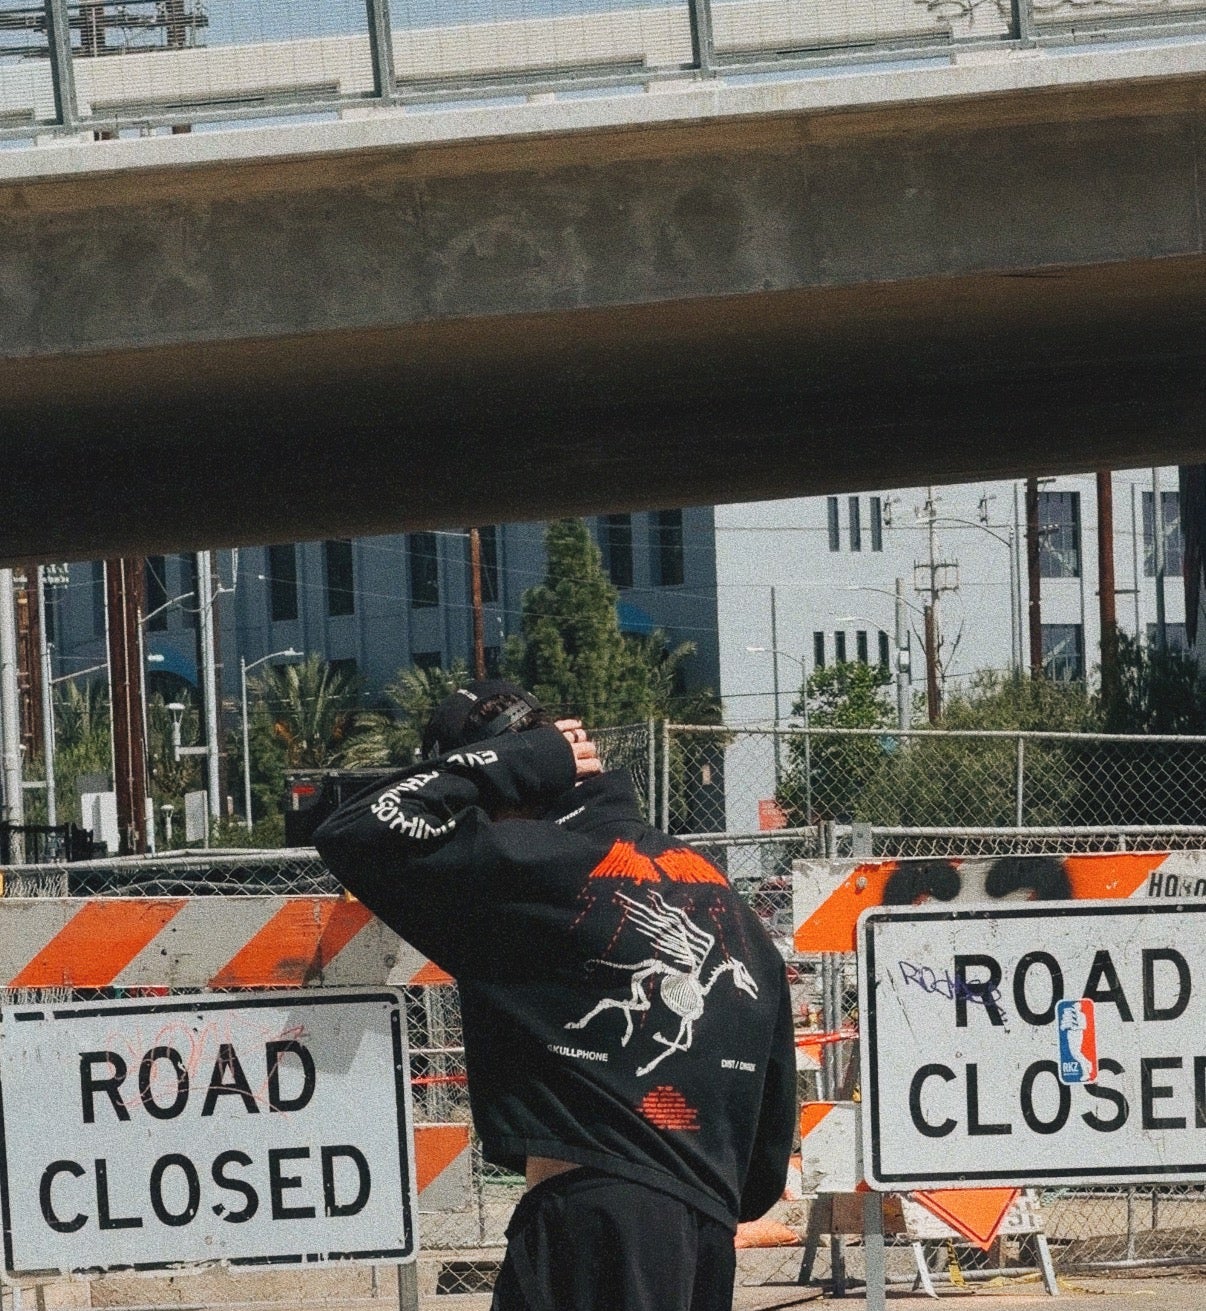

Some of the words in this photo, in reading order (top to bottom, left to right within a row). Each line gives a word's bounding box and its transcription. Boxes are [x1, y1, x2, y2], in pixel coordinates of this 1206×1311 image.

[954, 948, 1192, 1028] ROAD
[79, 1040, 317, 1124] ROAD
[909, 1057, 1206, 1138] CLOSE
[39, 1144, 372, 1234] CLOSED
